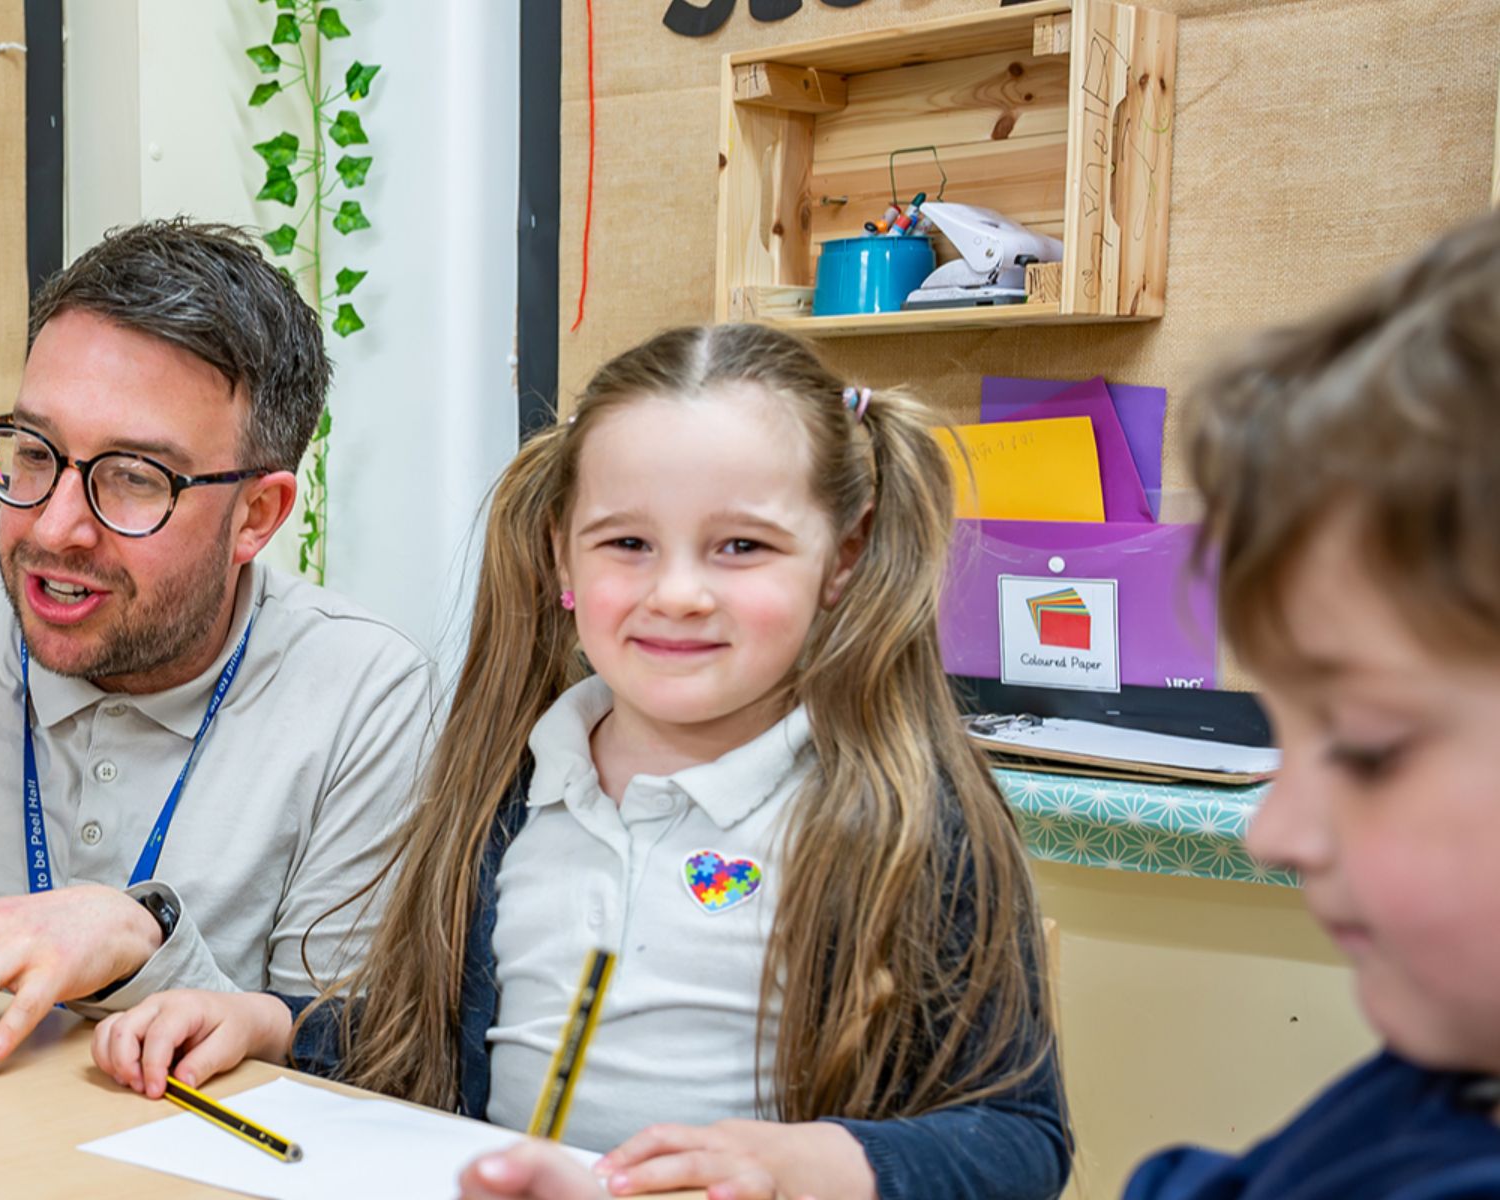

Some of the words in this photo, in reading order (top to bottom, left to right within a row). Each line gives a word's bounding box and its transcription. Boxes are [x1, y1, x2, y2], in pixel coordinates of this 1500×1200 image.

[1019, 652, 1067, 669] Coloured
[1071, 656, 1103, 673] Paper
[27, 779, 39, 808] Hall
[30, 811, 43, 846] Peel
[33, 849, 46, 869] be
[35, 872, 48, 890] to
